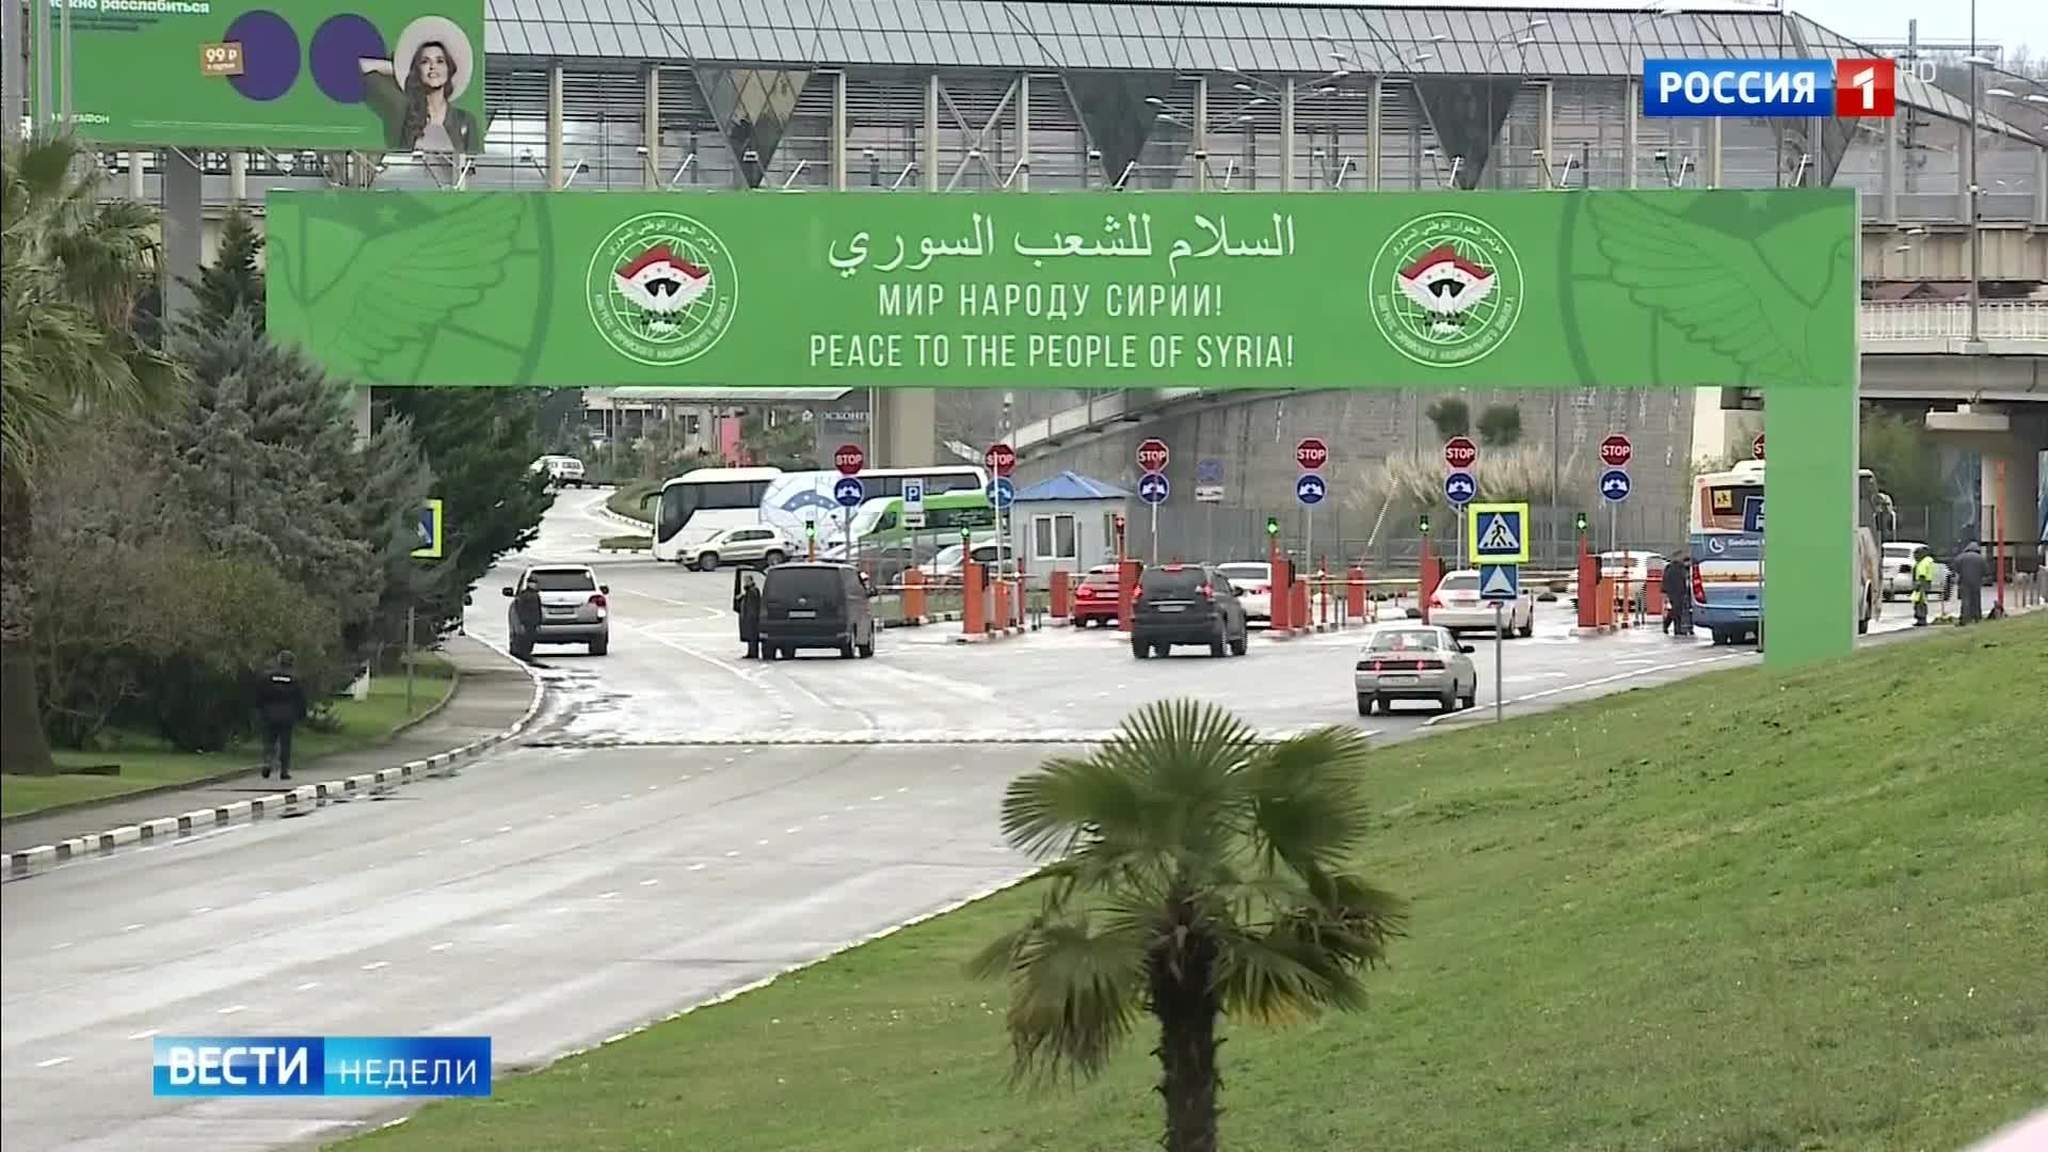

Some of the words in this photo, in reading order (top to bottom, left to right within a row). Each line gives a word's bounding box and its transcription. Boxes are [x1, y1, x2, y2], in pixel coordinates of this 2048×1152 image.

[206, 48, 226, 62] 99
[828, 212, 994, 278] السوري
[1014, 212, 1153, 267] للشعب
[1168, 212, 1295, 278] السلام
[879, 284, 944, 316] МИР
[960, 284, 1090, 320] НАРОДУ
[1106, 284, 1222, 317] СИРИИ!
[810, 334, 902, 367] PEACE
[914, 334, 949, 367] TO
[962, 334, 1016, 367] THE
[1029, 334, 1137, 368] PEOPLE
[1150, 335, 1184, 368] OF
[1196, 335, 1294, 368] SYRIA!
[1139, 450, 1166, 462] STOP
[1298, 449, 1326, 460] STOP
[1446, 447, 1475, 460] STOP
[1602, 444, 1630, 457] STOP
[836, 454, 863, 465] STOP
